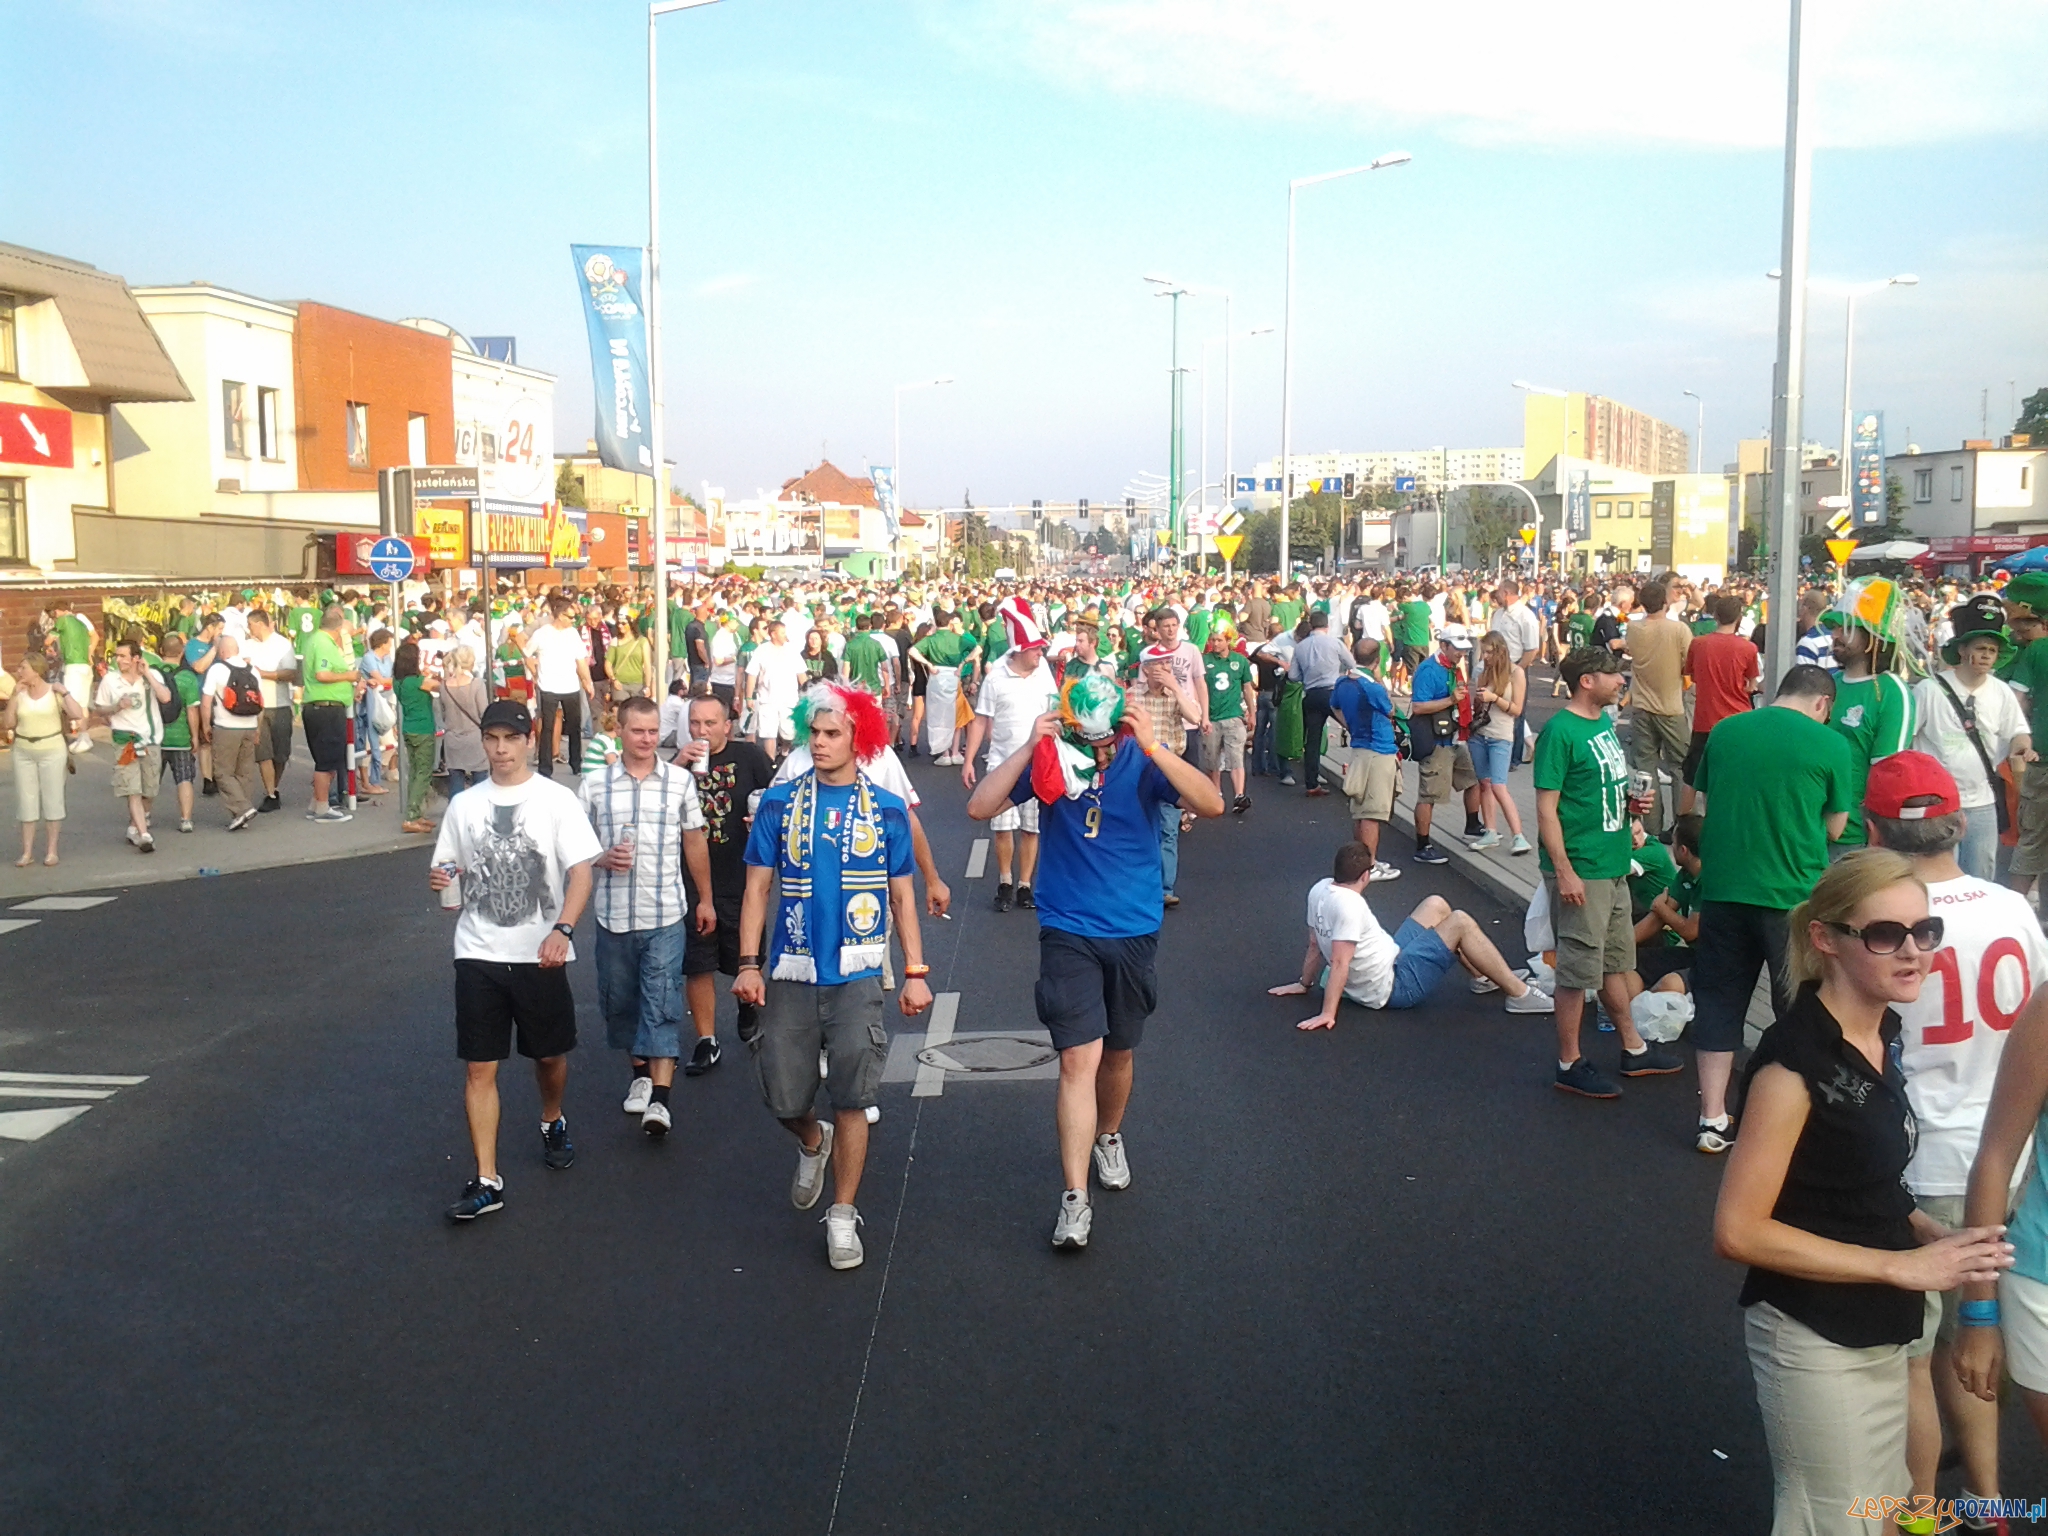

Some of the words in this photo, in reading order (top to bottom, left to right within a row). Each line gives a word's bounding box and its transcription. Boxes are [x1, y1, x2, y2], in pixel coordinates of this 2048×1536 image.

[484, 512, 526, 552] EVERLY
[301, 612, 314, 633] 8
[1214, 671, 1230, 691] 3
[1083, 805, 1102, 839] 9
[1932, 890, 1989, 906] POLSKA
[1921, 936, 2031, 1046] 10
